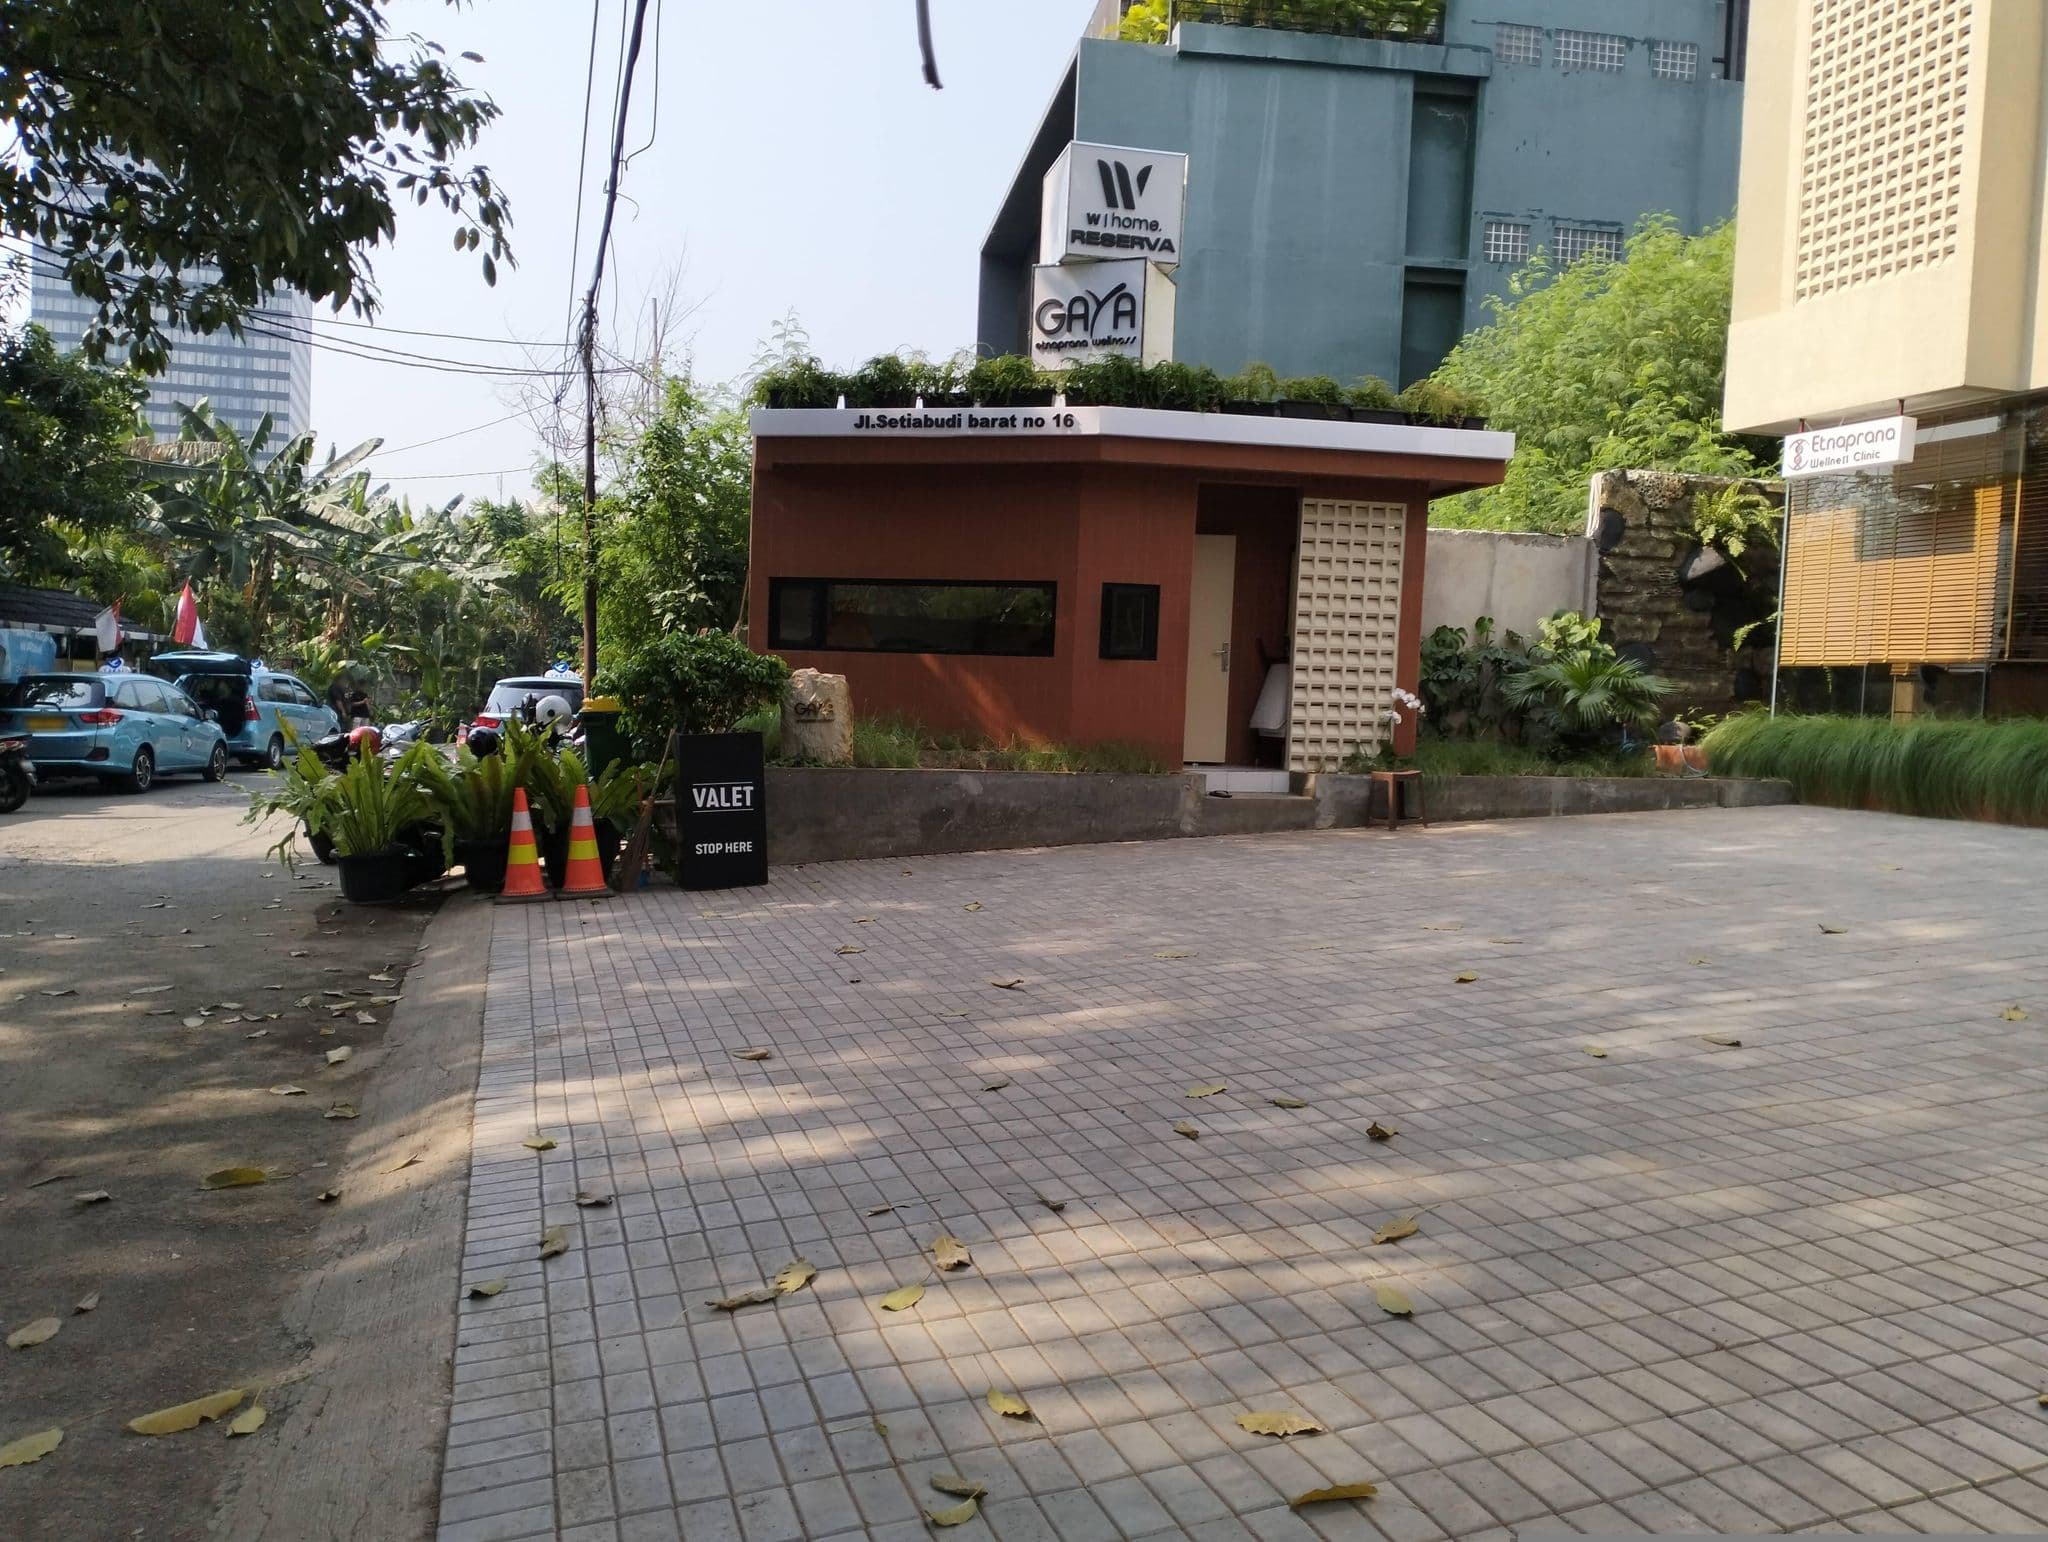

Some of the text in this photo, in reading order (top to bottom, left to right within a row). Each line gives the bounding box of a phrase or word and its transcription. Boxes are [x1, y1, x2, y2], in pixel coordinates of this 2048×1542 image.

[1071, 229, 1175, 253] RESERVA
[1035, 282, 1136, 338] GAYA
[968, 413, 1017, 429] barat
[1023, 416, 1045, 428] no
[1053, 413, 1074, 428] 16
[1812, 427, 1896, 453] Etnaprana
[1810, 450, 1880, 469] Wellness Clinic
[692, 786, 754, 808] VALET
[695, 841, 752, 855] STOP HERE
